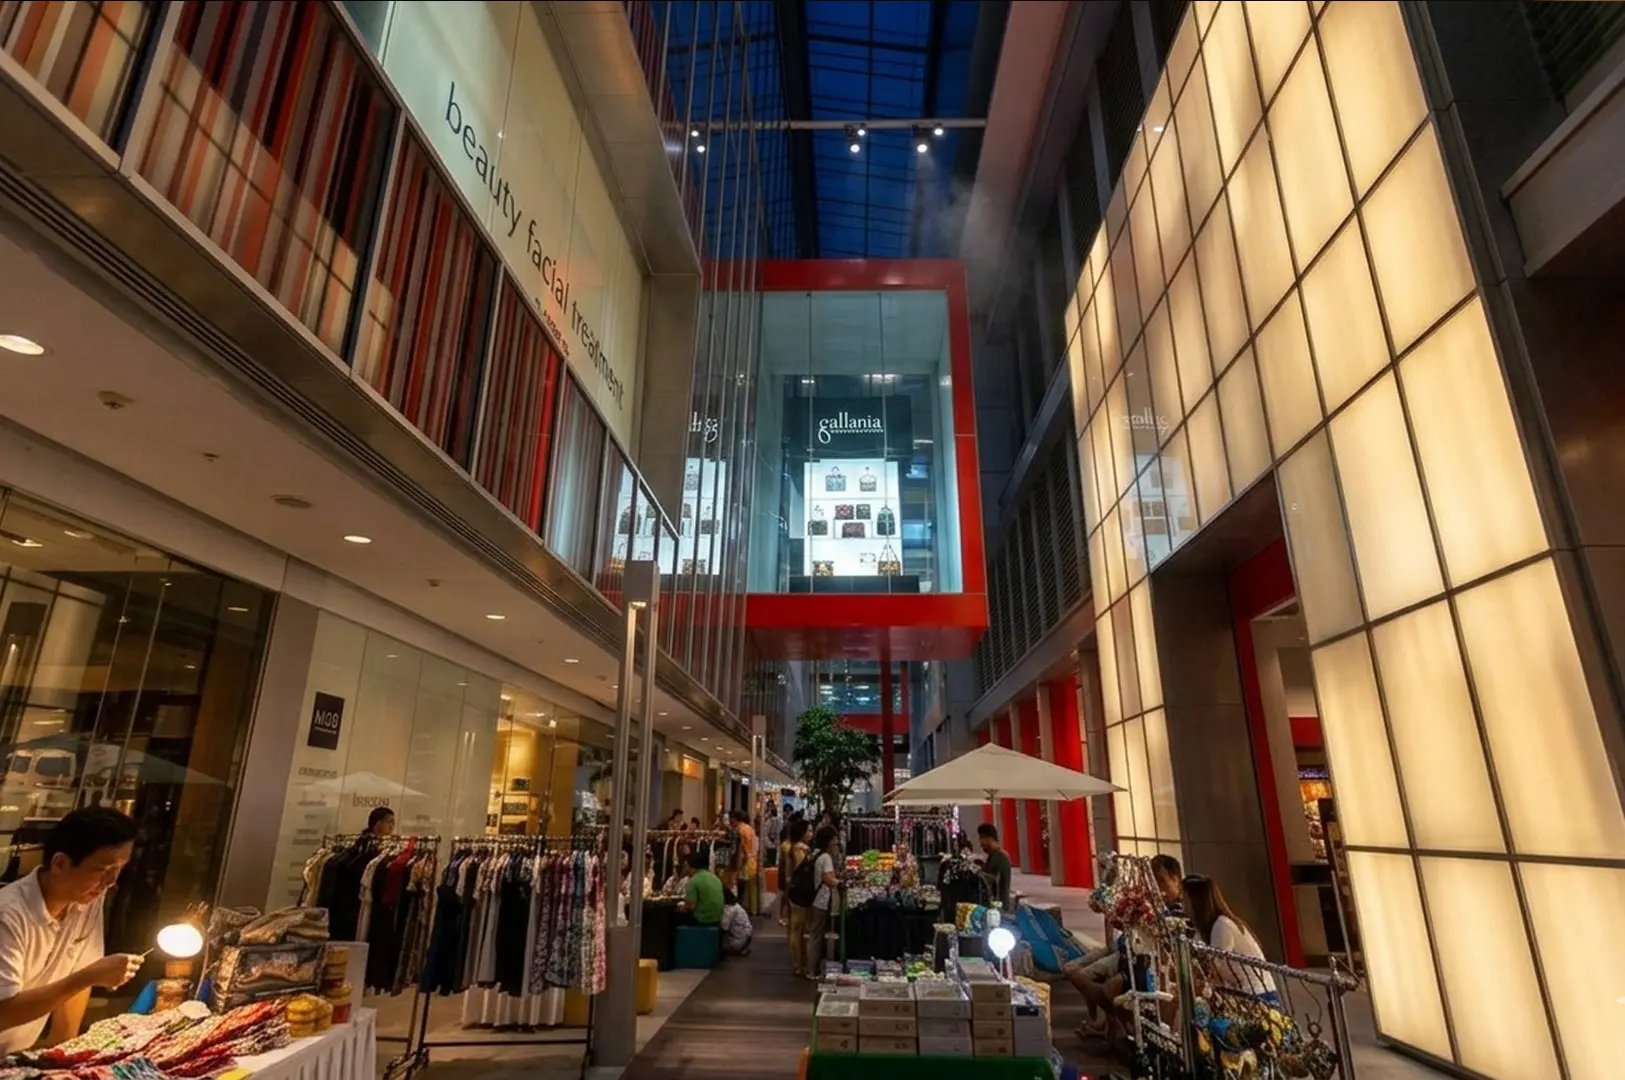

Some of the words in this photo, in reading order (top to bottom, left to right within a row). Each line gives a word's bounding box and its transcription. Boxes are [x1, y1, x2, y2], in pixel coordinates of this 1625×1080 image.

[446, 81, 522, 237] beauty
[527, 219, 569, 314] facial
[572, 301, 624, 410] treatment
[818, 411, 882, 444] gallania
